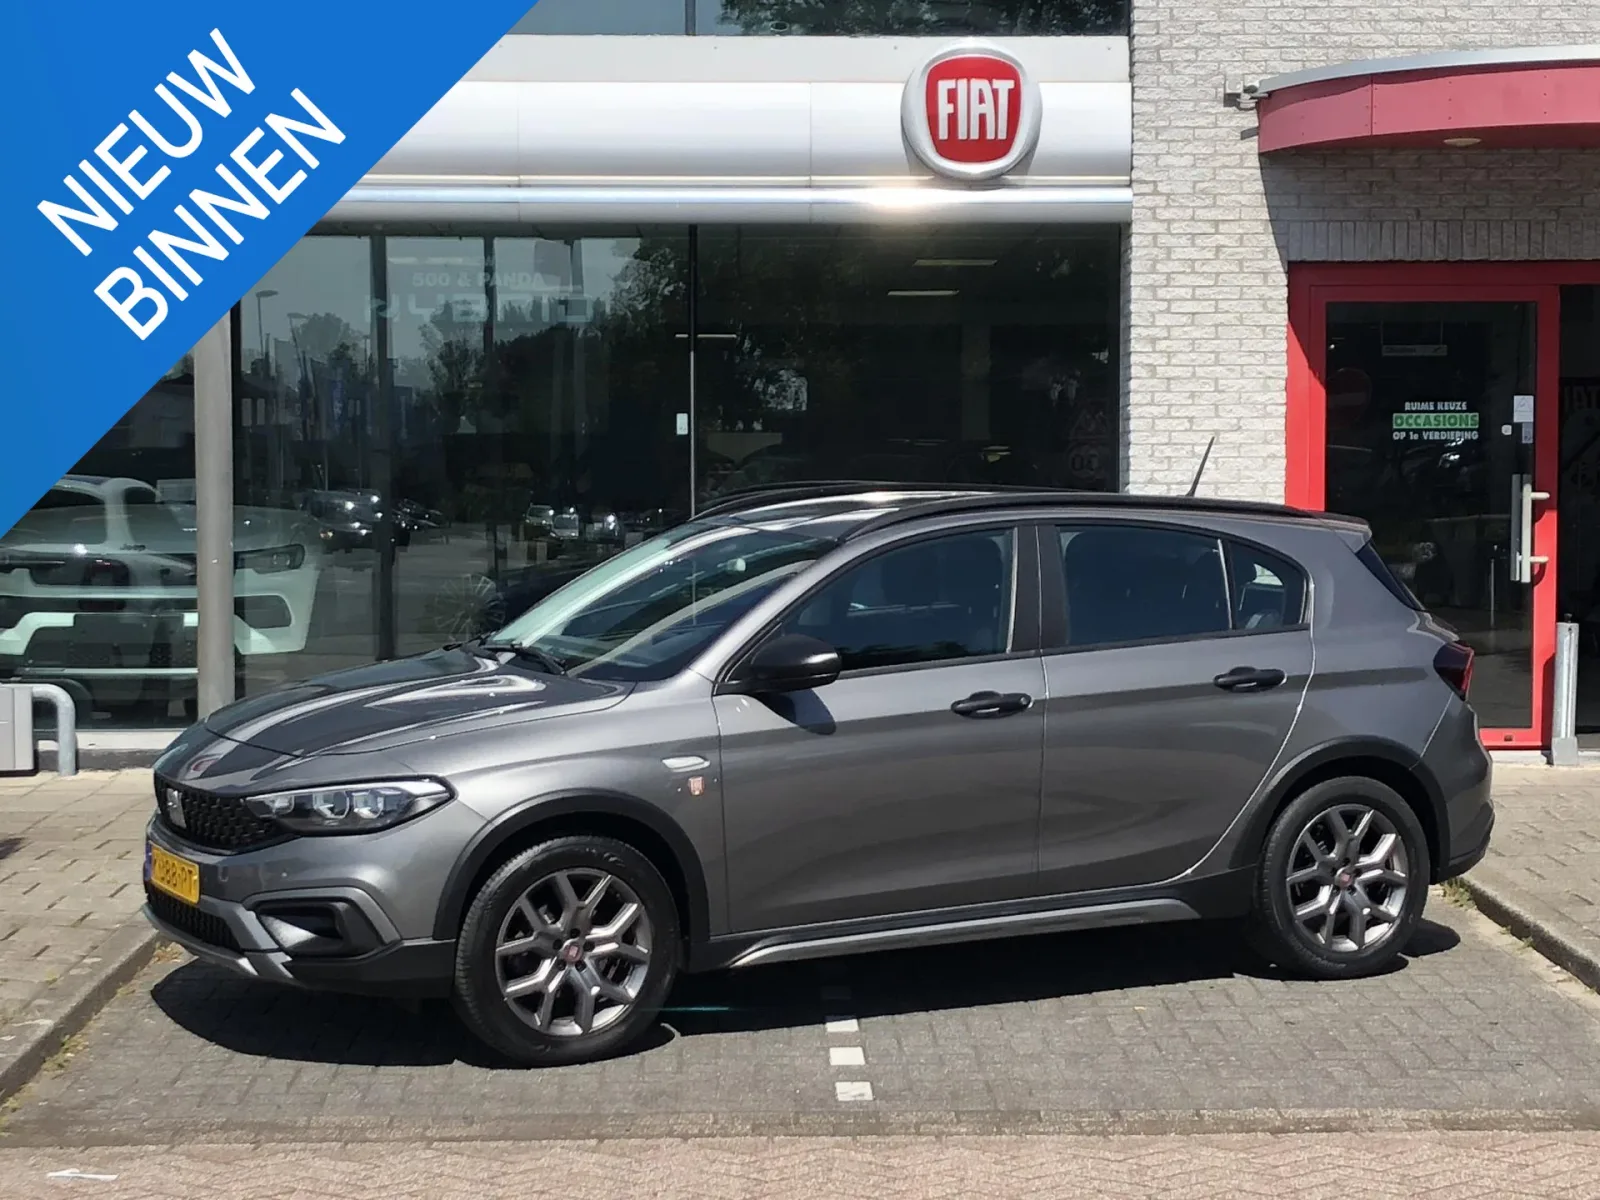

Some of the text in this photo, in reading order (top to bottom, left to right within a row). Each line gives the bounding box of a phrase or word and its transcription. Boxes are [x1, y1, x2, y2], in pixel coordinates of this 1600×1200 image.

[937, 78, 1015, 140] FIAT
[412, 272, 545, 288] 500 & PANDA
[1404, 401, 1468, 411] RUIME KEUZE
[1394, 414, 1479, 427] OCCASIONS
[1393, 431, 1479, 440] OP 1e VERDIEPING
